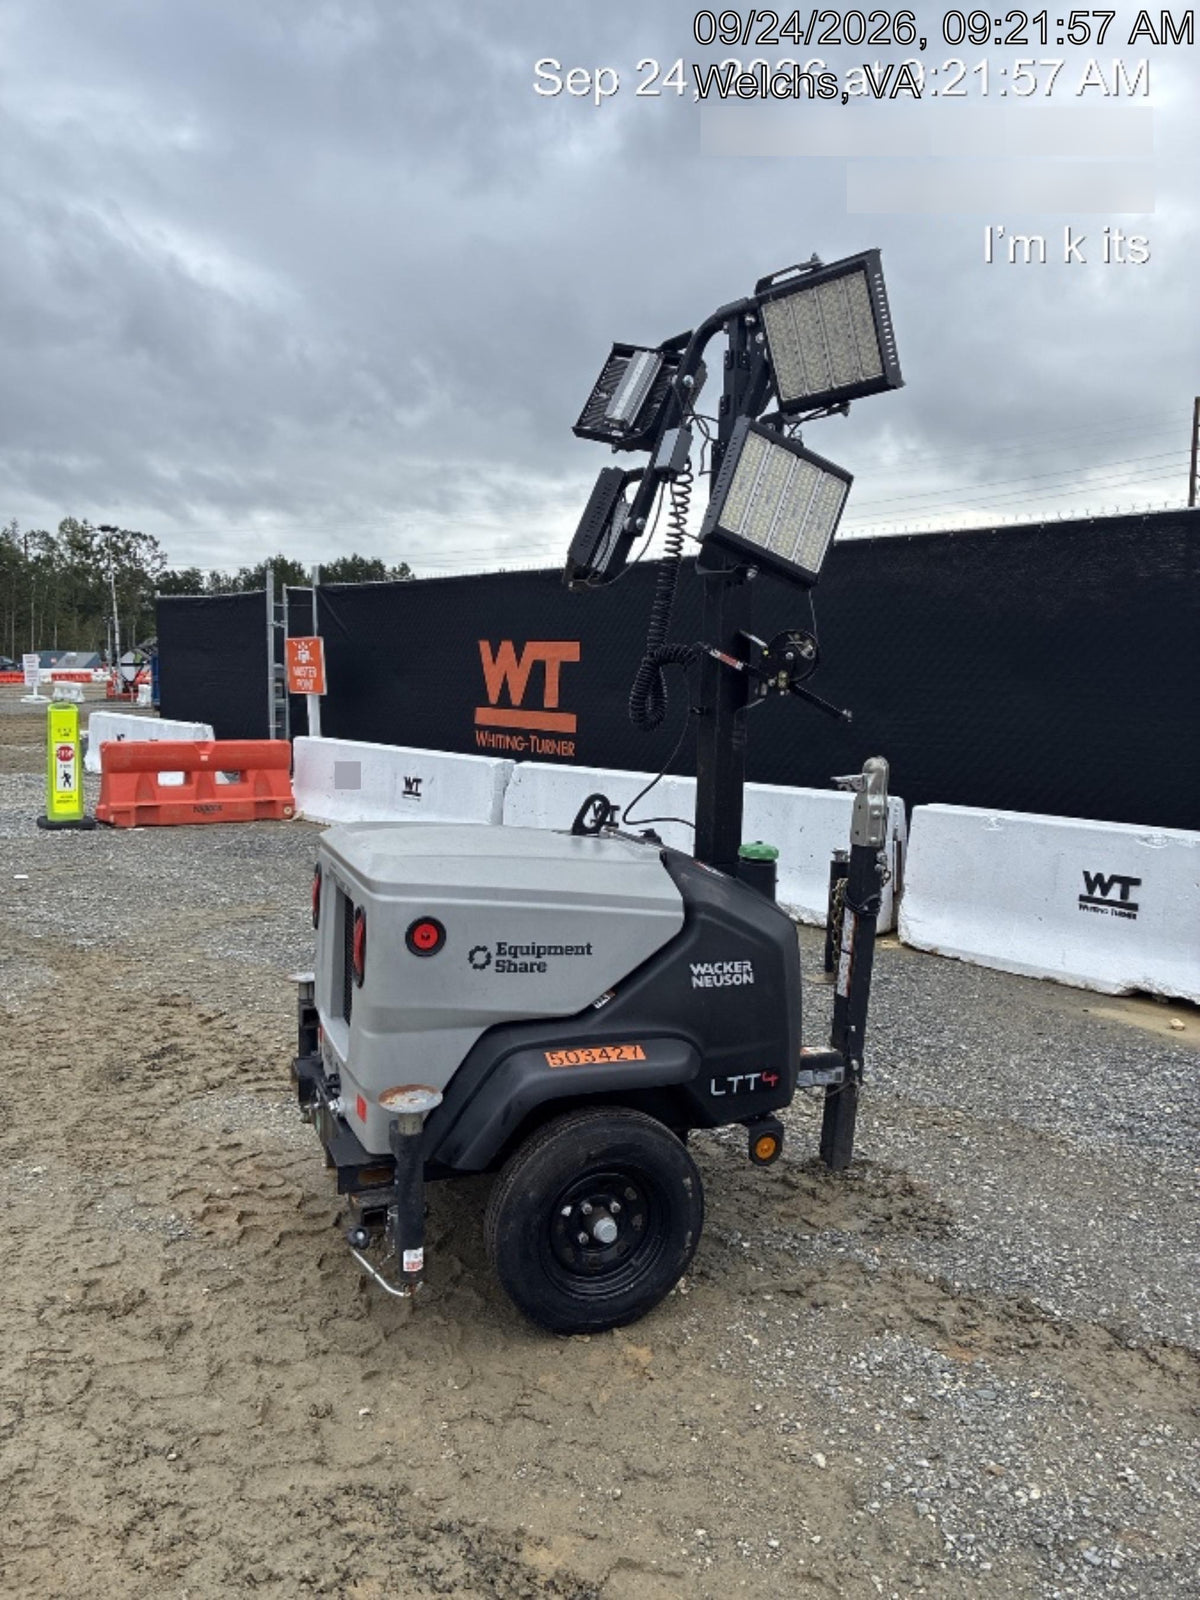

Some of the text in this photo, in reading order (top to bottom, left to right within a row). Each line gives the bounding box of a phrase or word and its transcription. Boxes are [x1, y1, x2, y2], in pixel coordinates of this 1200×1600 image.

[478, 639, 581, 709] WT
[475, 730, 576, 757] WHITING-TURNER
[403, 776, 423, 792] WT
[1082, 870, 1142, 901] WT
[495, 941, 593, 958] Equipment
[495, 959, 548, 973] Share
[689, 961, 753, 975] WACKER
[691, 973, 755, 988] NEUSON
[710, 1071, 779, 1097] LTT4
